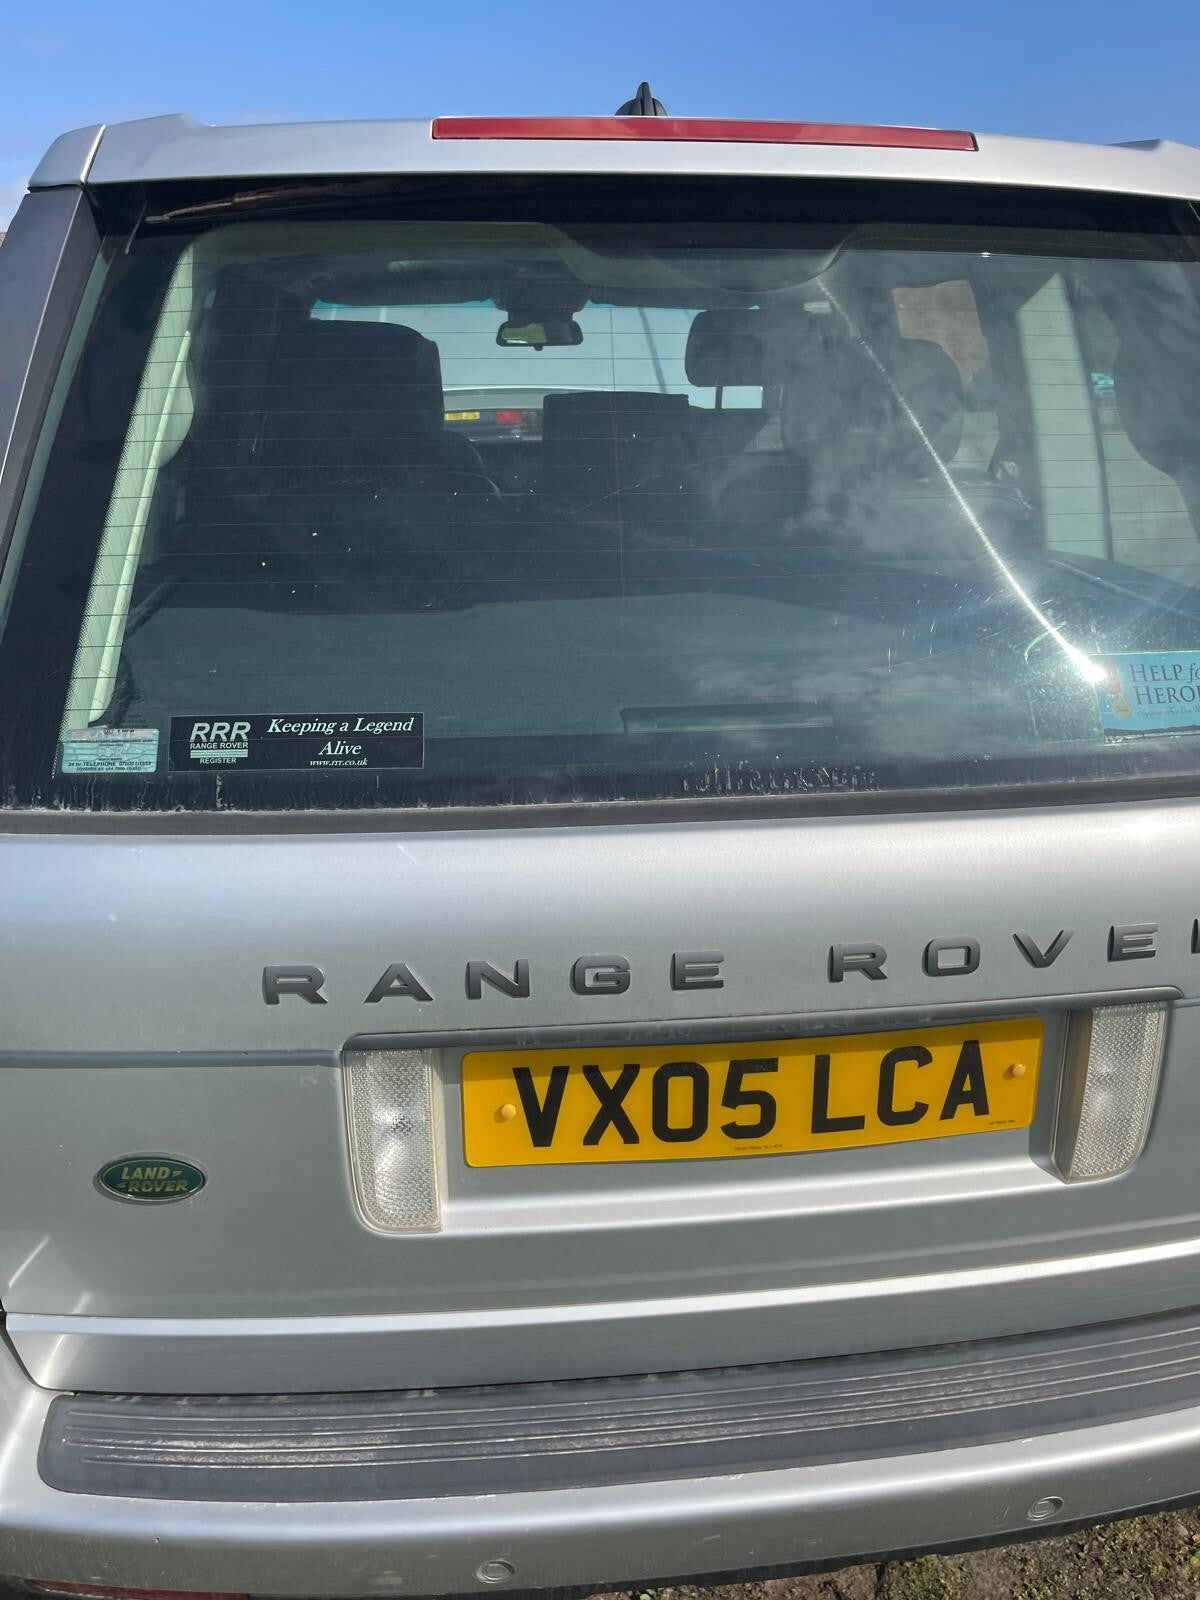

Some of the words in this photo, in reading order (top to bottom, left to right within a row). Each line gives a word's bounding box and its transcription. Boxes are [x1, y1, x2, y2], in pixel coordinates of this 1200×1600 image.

[1129, 663, 1183, 682] HELP
[189, 721, 251, 742] RRR
[266, 718, 337, 735] Keeping
[339, 722, 349, 732] a
[352, 717, 415, 735] Legend
[190, 742, 218, 750] RANGE
[219, 741, 249, 749] ROVER
[318, 740, 362, 756] Alive
[309, 758, 368, 767] www.rrr.co.uk
[262, 950, 725, 1005] RANGE
[827, 917, 1200, 983] ROVE
[512, 1057, 780, 1148] VX05
[810, 1039, 991, 1135] LCA
[120, 1166, 170, 1180] LAND
[127, 1180, 189, 1193] ROVER
